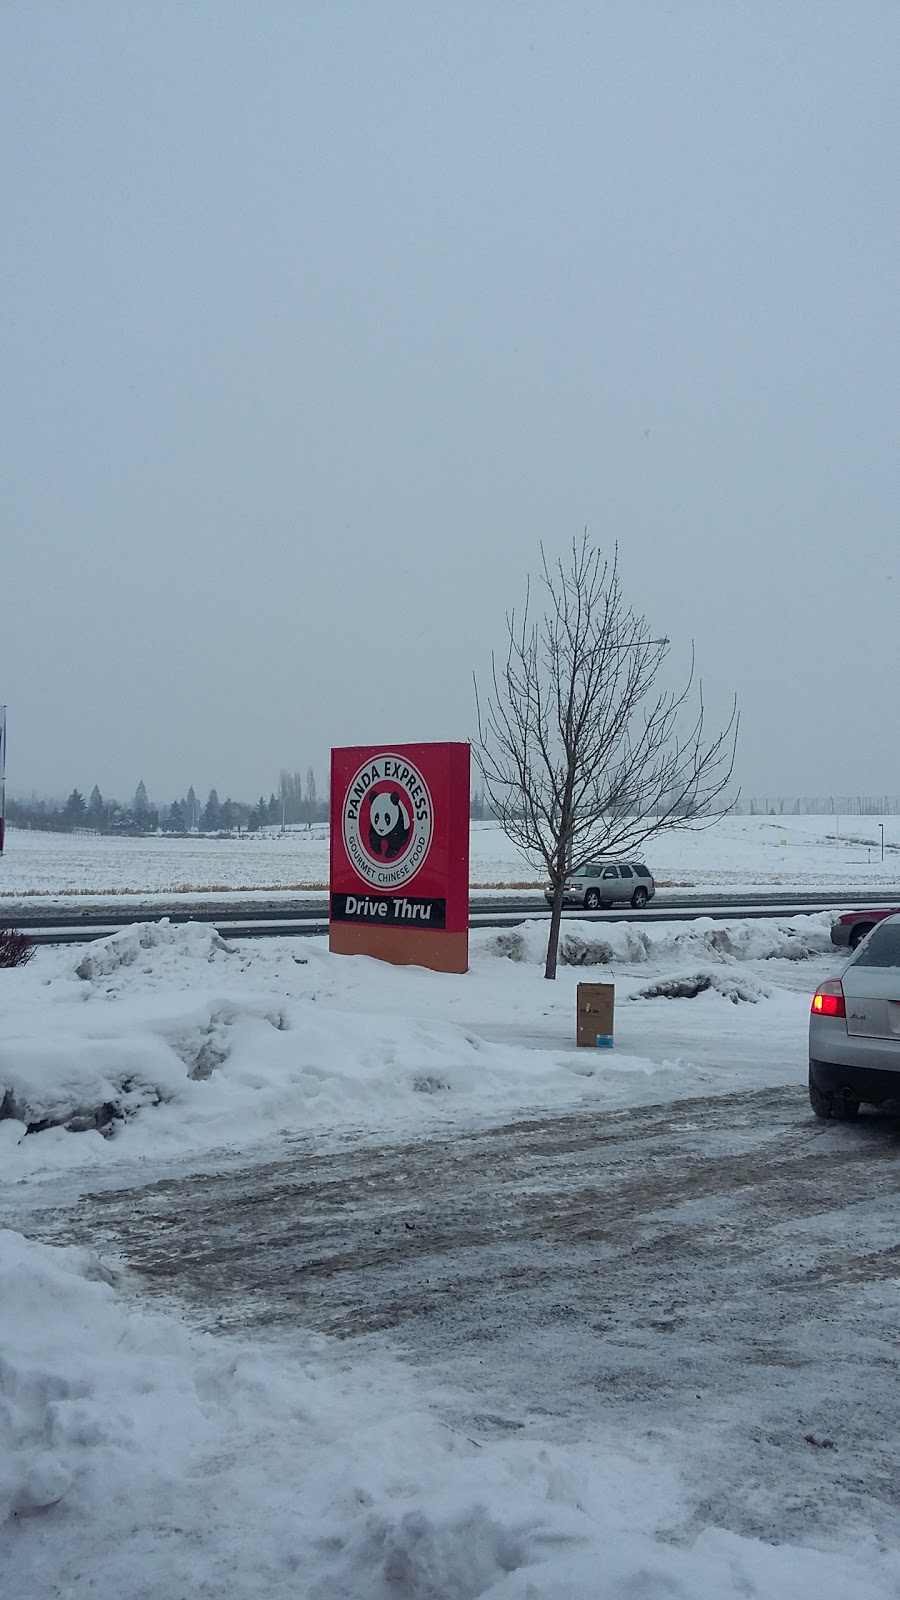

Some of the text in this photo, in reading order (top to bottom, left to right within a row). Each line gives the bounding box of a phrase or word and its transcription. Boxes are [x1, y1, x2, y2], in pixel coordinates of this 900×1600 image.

[348, 761, 428, 821] PANDA EXPRESS
[348, 836, 426, 882] GOURMET CHINESE FOOD
[345, 896, 432, 919] Drive Thru
